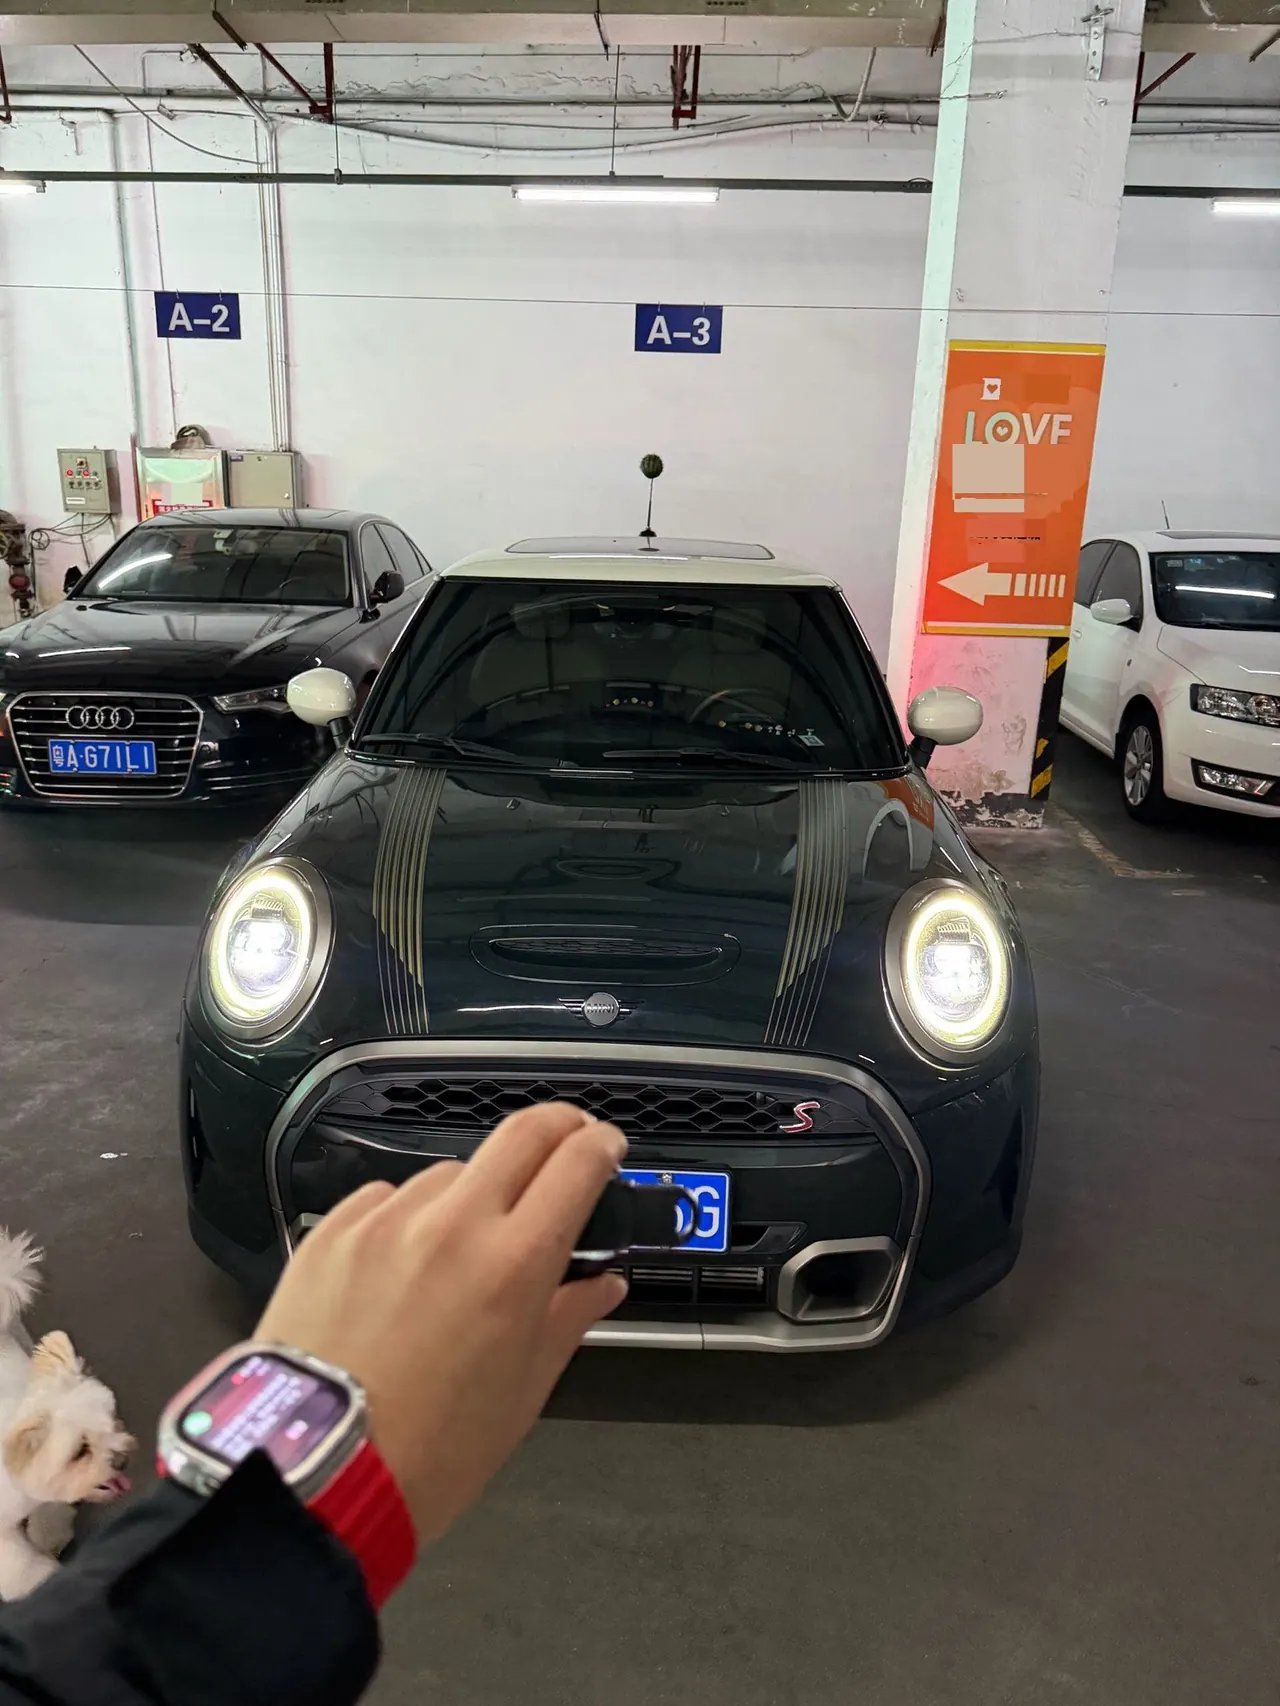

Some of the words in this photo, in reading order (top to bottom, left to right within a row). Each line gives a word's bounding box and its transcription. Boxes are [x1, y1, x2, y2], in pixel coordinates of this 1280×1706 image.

[168, 302, 230, 333] A-2
[646, 315, 711, 346] A-3
[586, 1002, 616, 1015] MINI
[779, 1100, 821, 1133] S
